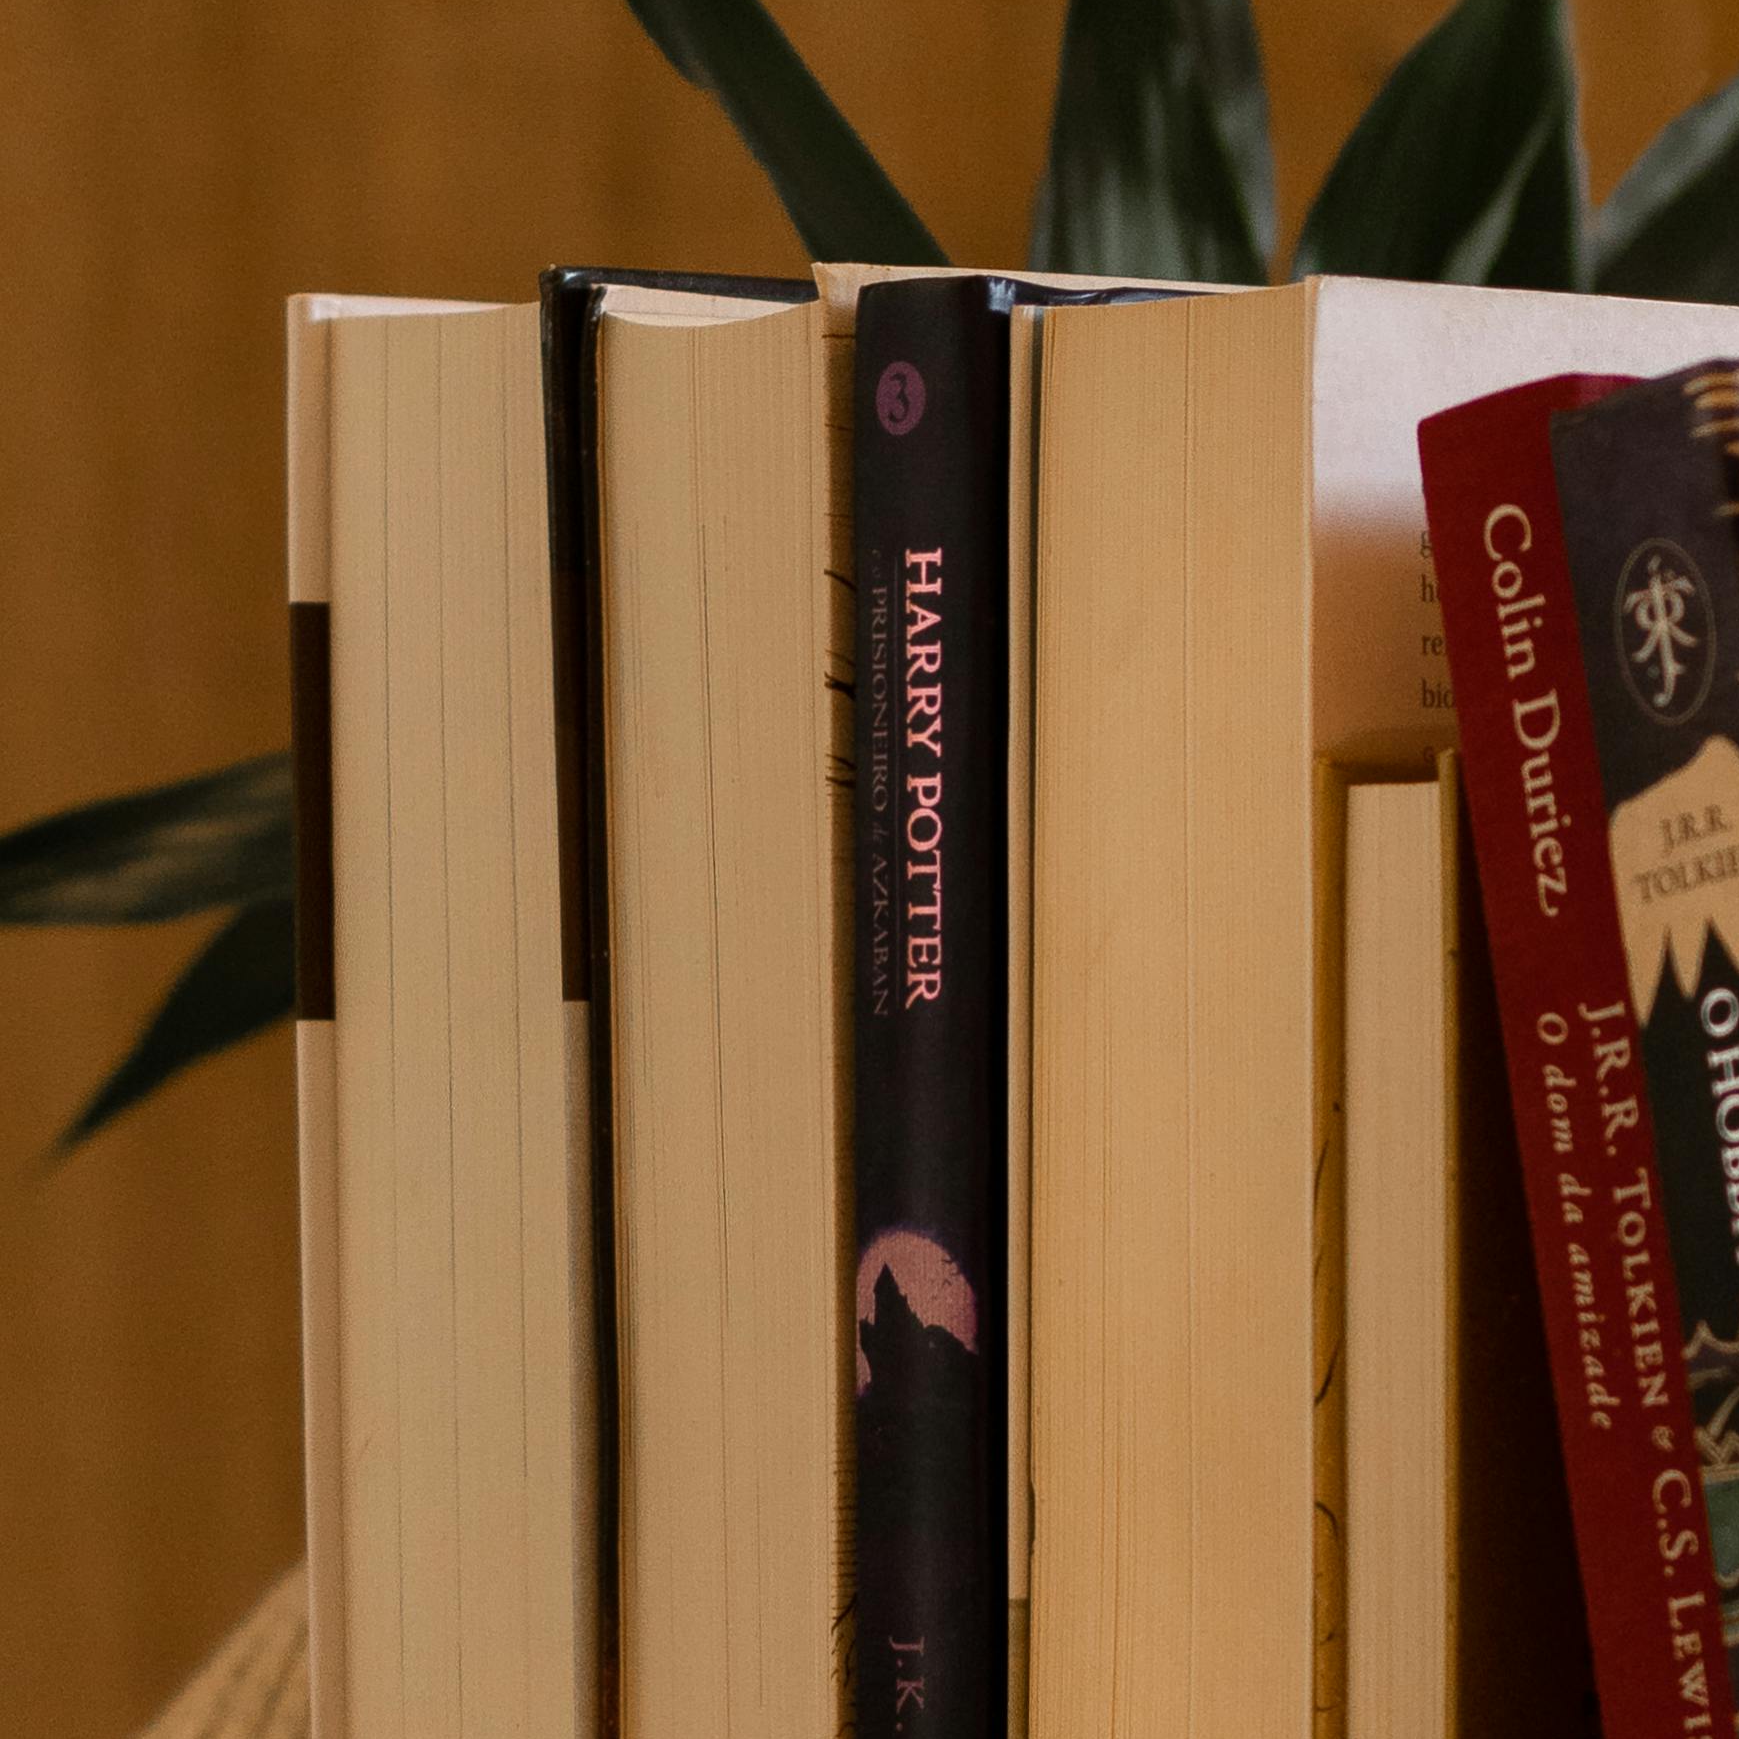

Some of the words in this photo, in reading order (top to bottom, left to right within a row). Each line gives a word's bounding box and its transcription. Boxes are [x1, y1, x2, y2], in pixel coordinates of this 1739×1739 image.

[905, 546, 942, 758] HARRY
[1484, 504, 1545, 680] Colin
[872, 586, 889, 812] PRISIONEIRO
[905, 771, 942, 1009] POTTER
[1511, 689, 1574, 917] Duriez
[874, 853, 889, 1016] AZKABAN
[1700, 987, 1739, 1037] O
[1537, 1010, 1569, 1047] O
[1541, 1063, 1573, 1154] dom
[1558, 1172, 1592, 1226] da
[1568, 1243, 1621, 1429] amizade
[1579, 1000, 1643, 1158] J.R.R.
[1611, 1167, 1671, 1411] TOLKIEN
[1652, 1469, 1701, 1580] C.S.
[889, 1636, 925, 1731] J.K.
